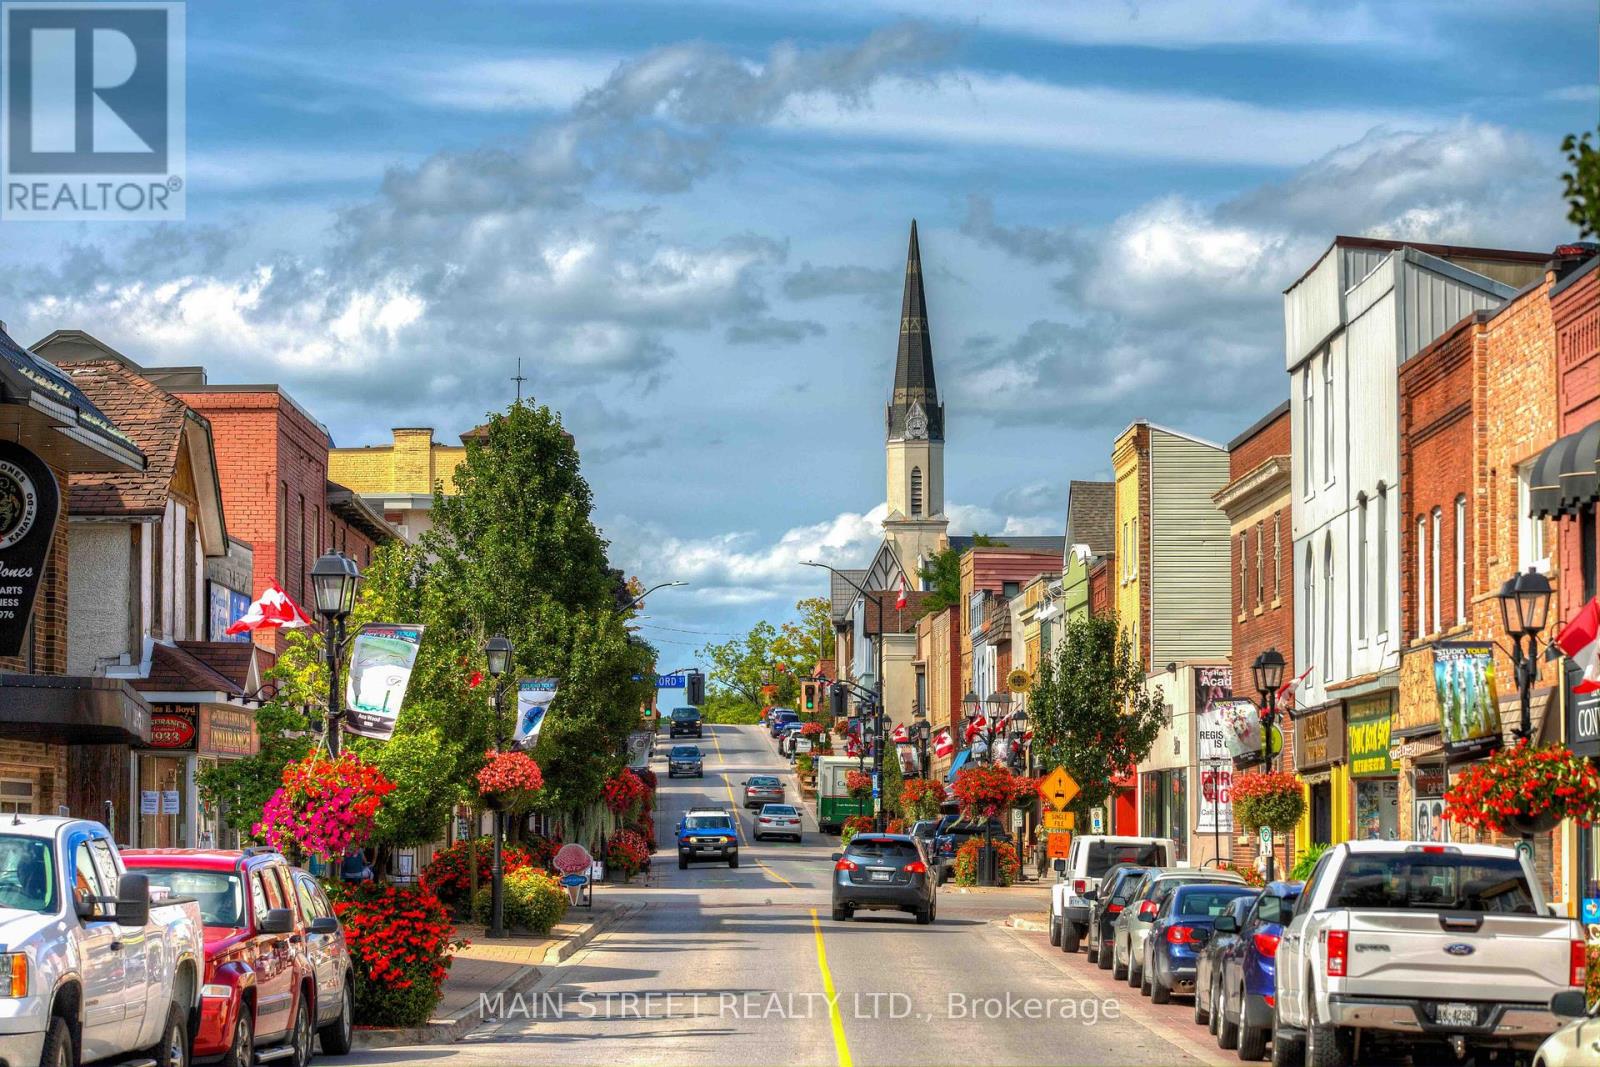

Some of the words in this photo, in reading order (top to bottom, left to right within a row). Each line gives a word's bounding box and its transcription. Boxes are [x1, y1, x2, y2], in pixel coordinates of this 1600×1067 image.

[0, 462, 26, 483] ONES
[9, 492, 34, 543] KARATE-DO
[1437, 648, 1466, 656] STUDIO
[657, 676, 677, 687] ORD
